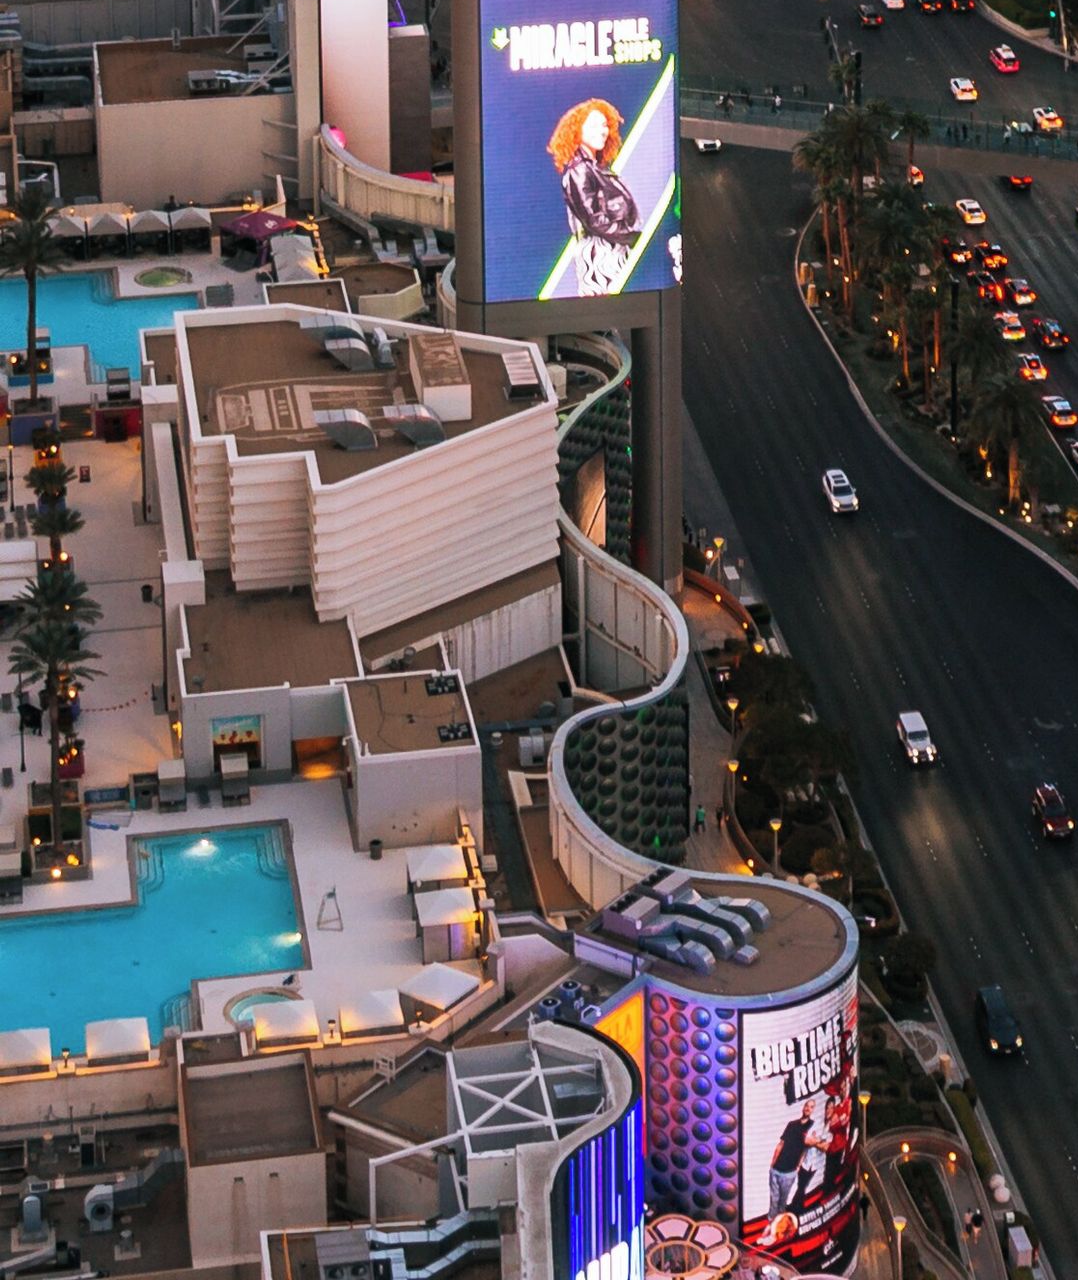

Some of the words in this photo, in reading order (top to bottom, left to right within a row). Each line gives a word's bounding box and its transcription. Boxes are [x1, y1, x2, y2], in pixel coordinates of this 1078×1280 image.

[509, 20, 614, 71] MIRACLE
[752, 1039, 796, 1080] BIG
[796, 1013, 842, 1066] TIME
[792, 1047, 841, 1101] RUSH
